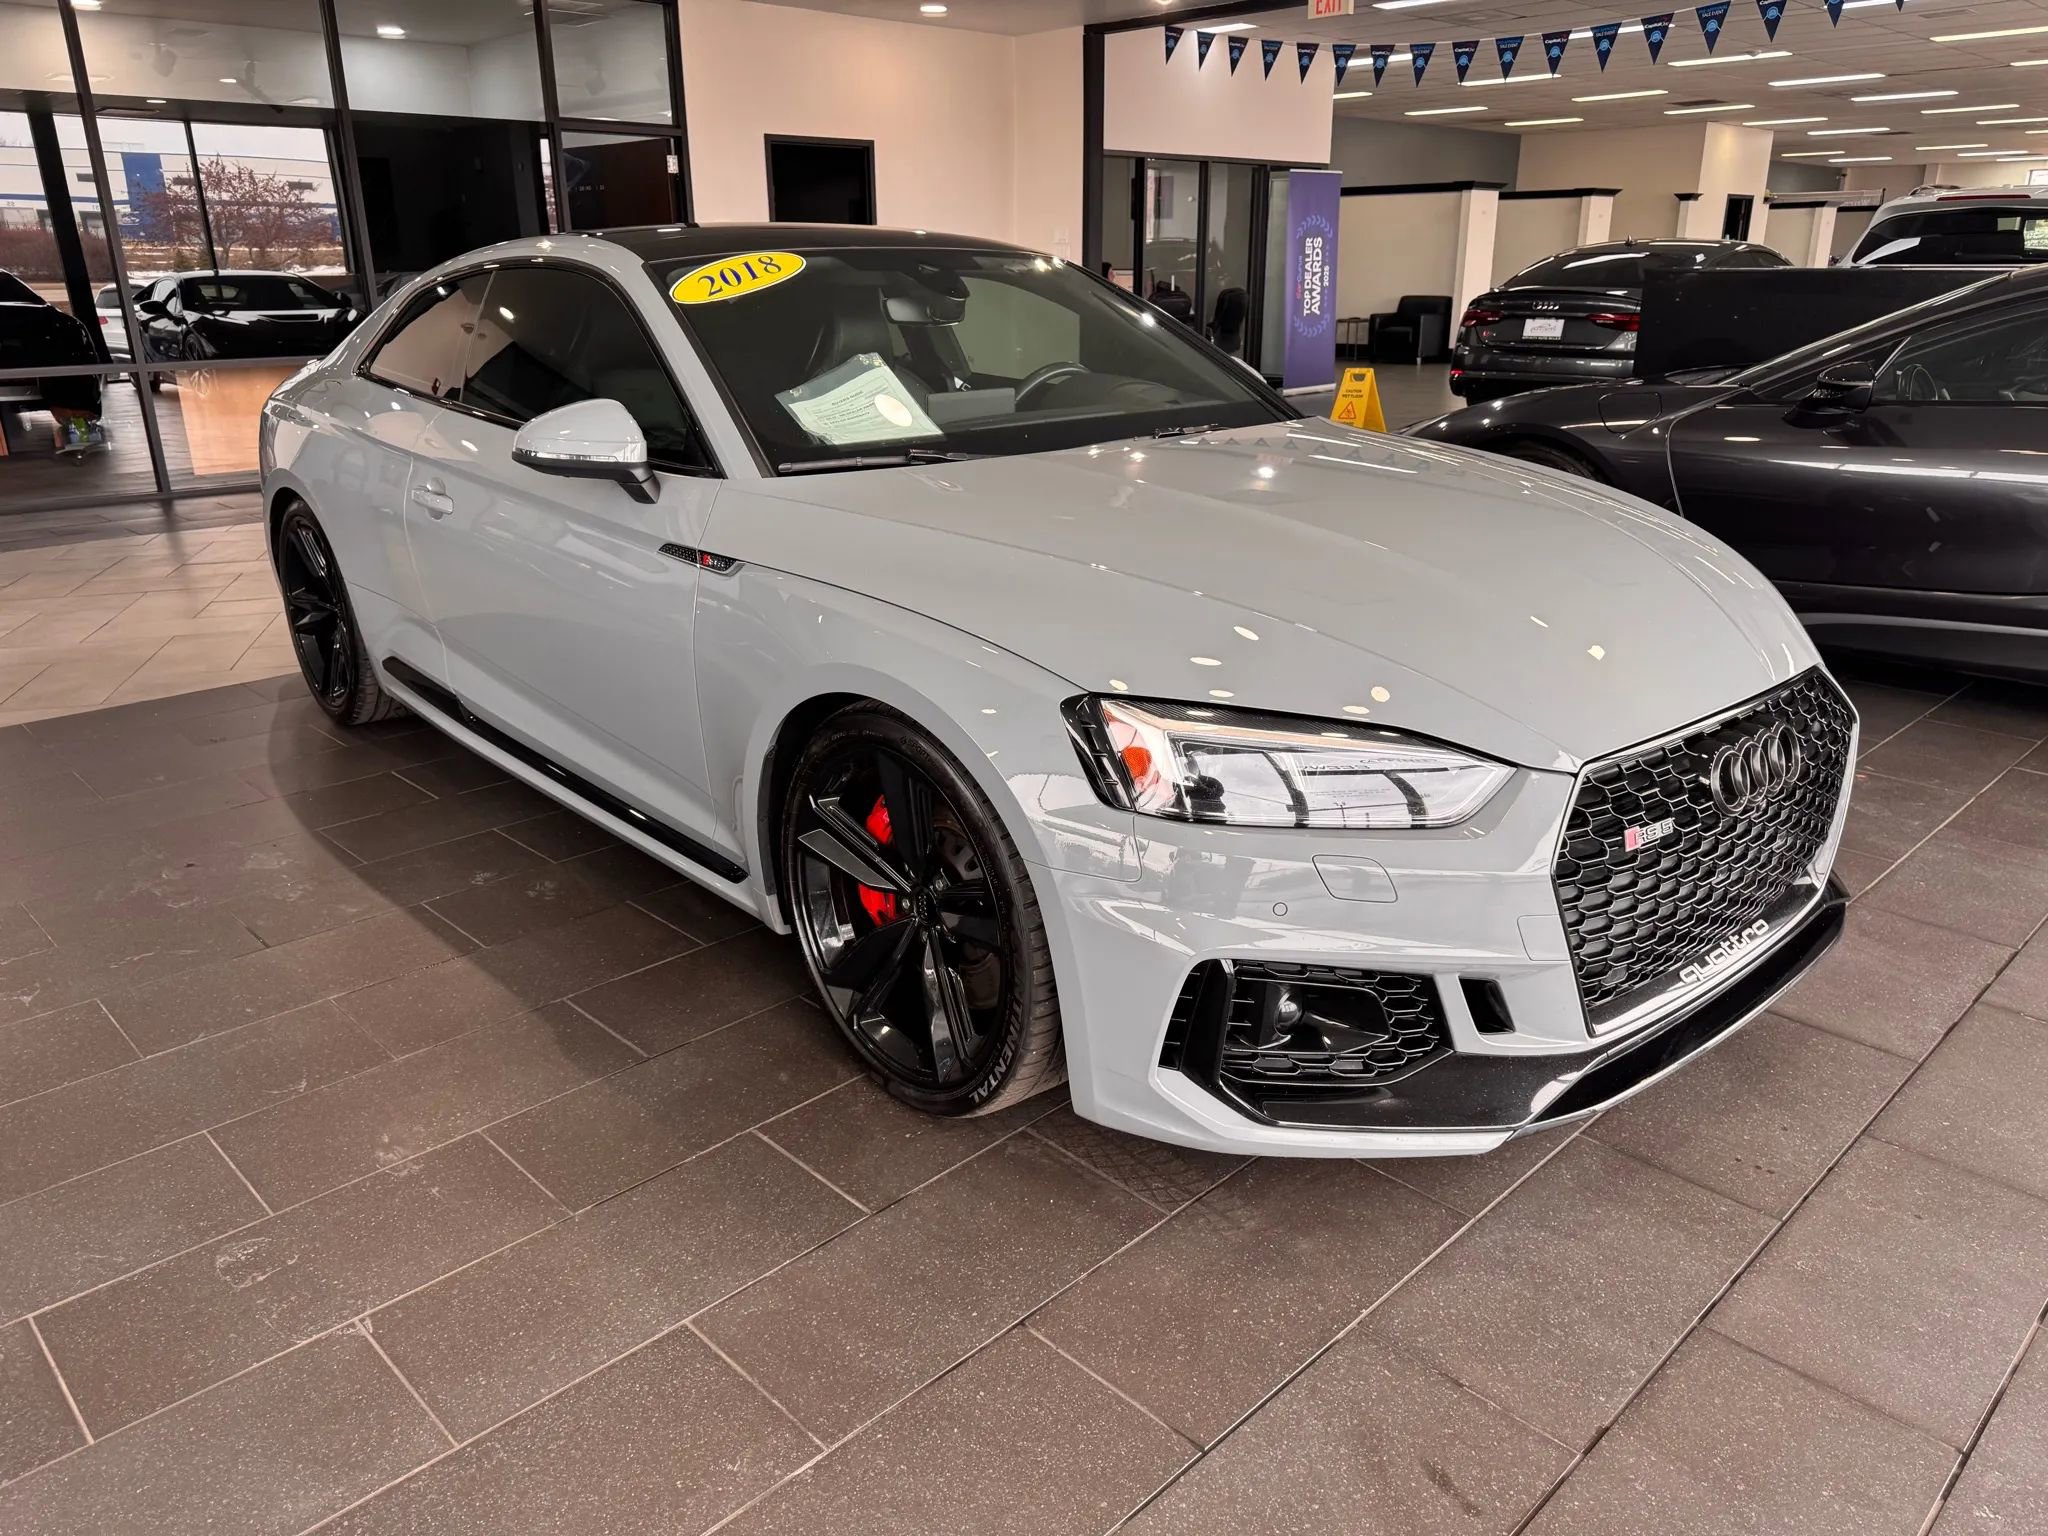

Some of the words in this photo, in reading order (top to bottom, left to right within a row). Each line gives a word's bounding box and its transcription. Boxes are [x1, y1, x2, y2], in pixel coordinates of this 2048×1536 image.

[698, 255, 782, 297] 2018
[1304, 237, 1314, 287] DEALER
[1311, 237, 1323, 316] AWARDS
[1304, 290, 1312, 317] TOP
[1679, 919, 1769, 984] quattro
